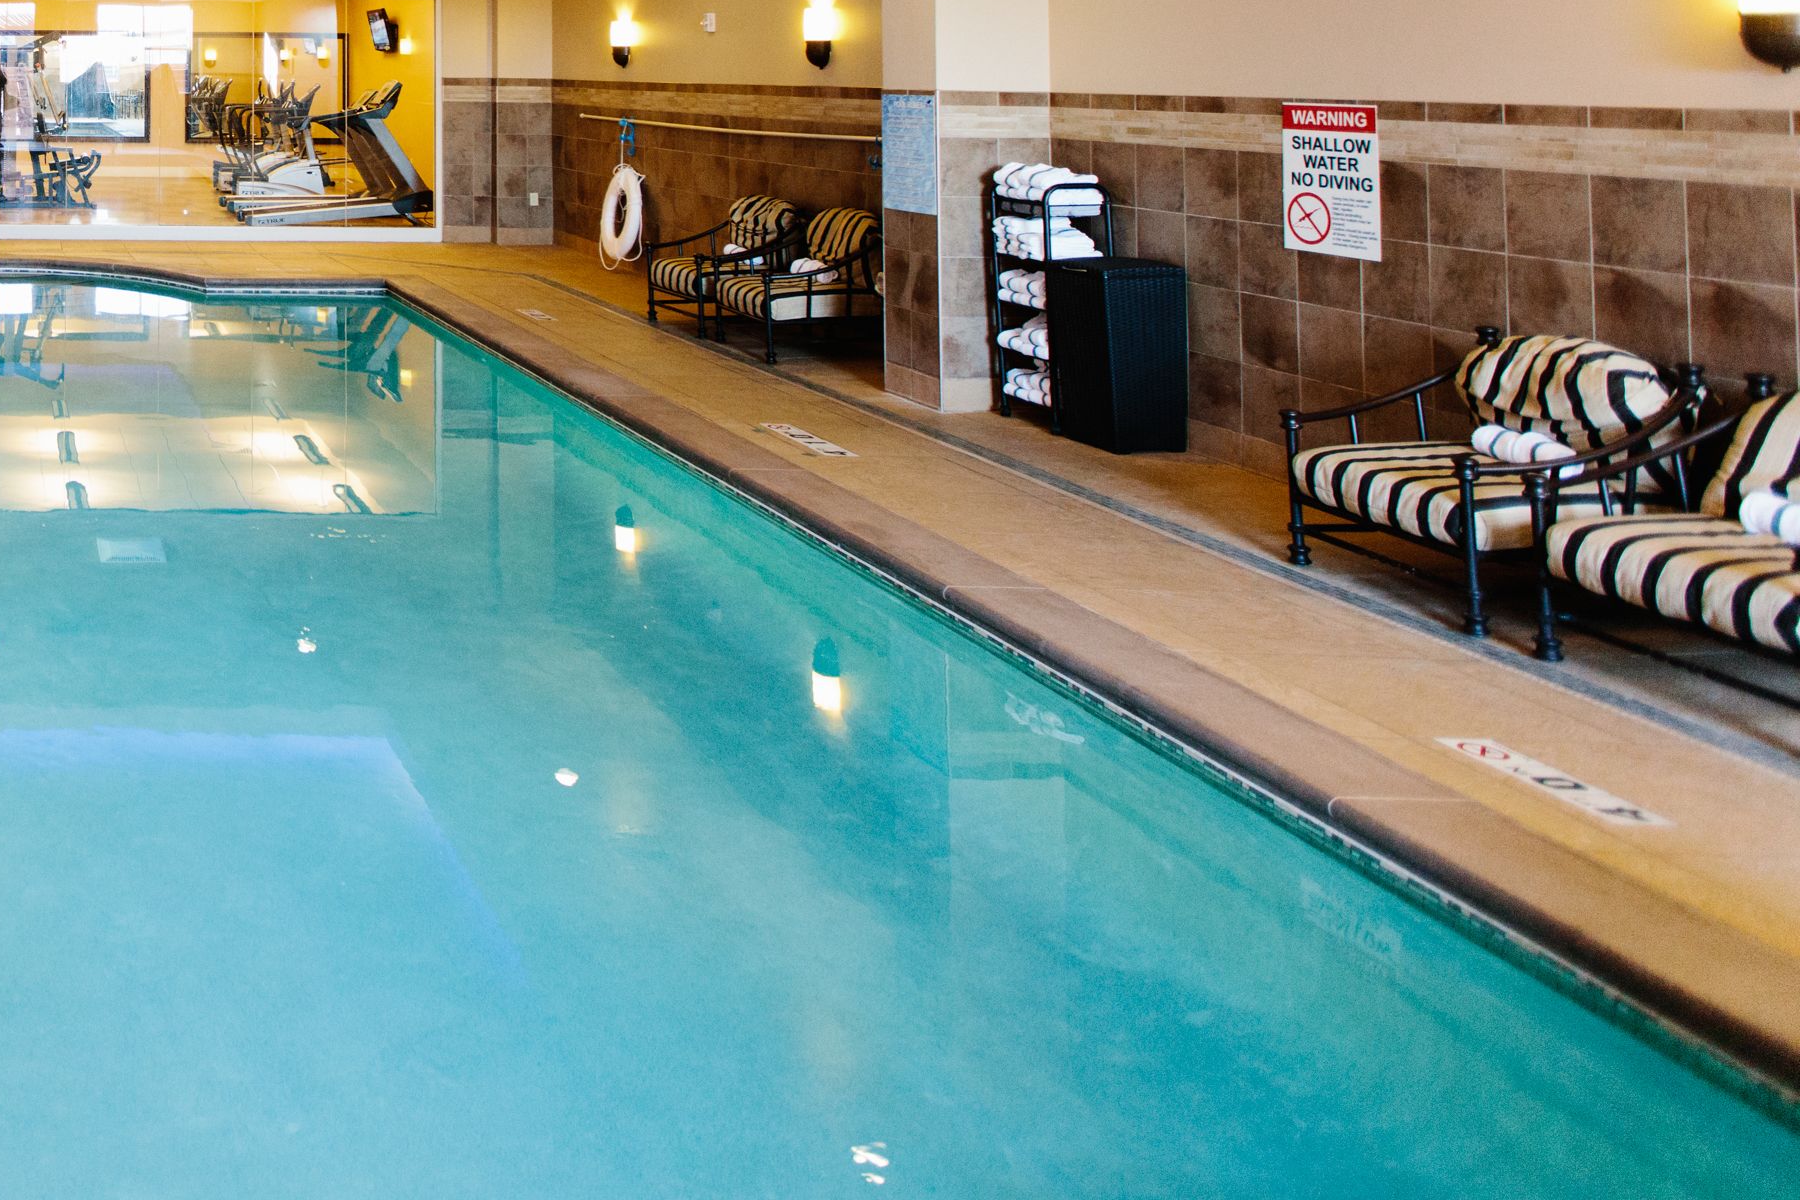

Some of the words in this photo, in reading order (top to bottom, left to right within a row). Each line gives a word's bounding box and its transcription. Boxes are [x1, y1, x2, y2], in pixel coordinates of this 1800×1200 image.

[1291, 110, 1368, 128] WARNING
[1291, 135, 1371, 154] SHALLOW
[1303, 155, 1360, 173] WATER
[1291, 172, 1314, 187] NO
[1318, 174, 1374, 193] DIVING
